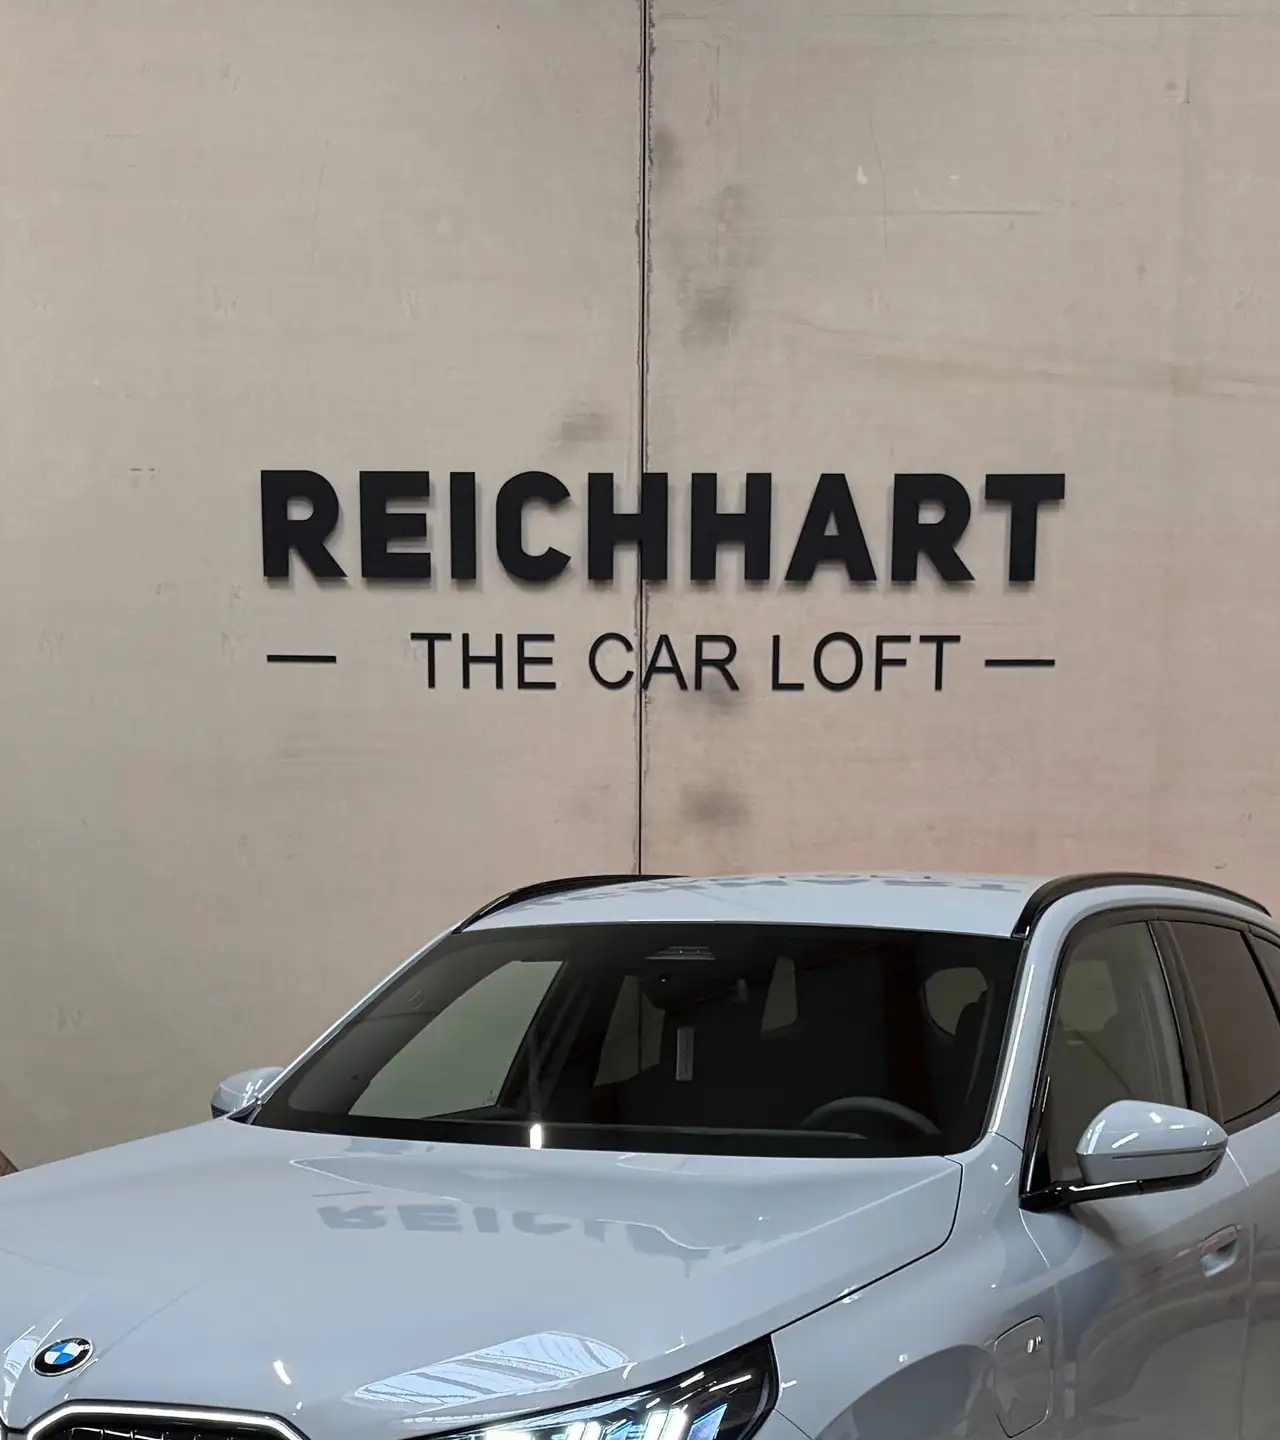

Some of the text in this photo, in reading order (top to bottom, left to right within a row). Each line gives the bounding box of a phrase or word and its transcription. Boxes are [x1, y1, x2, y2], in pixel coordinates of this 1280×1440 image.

[261, 469, 1066, 585] REICHHART
[410, 631, 961, 692] THE CAR LOFT
